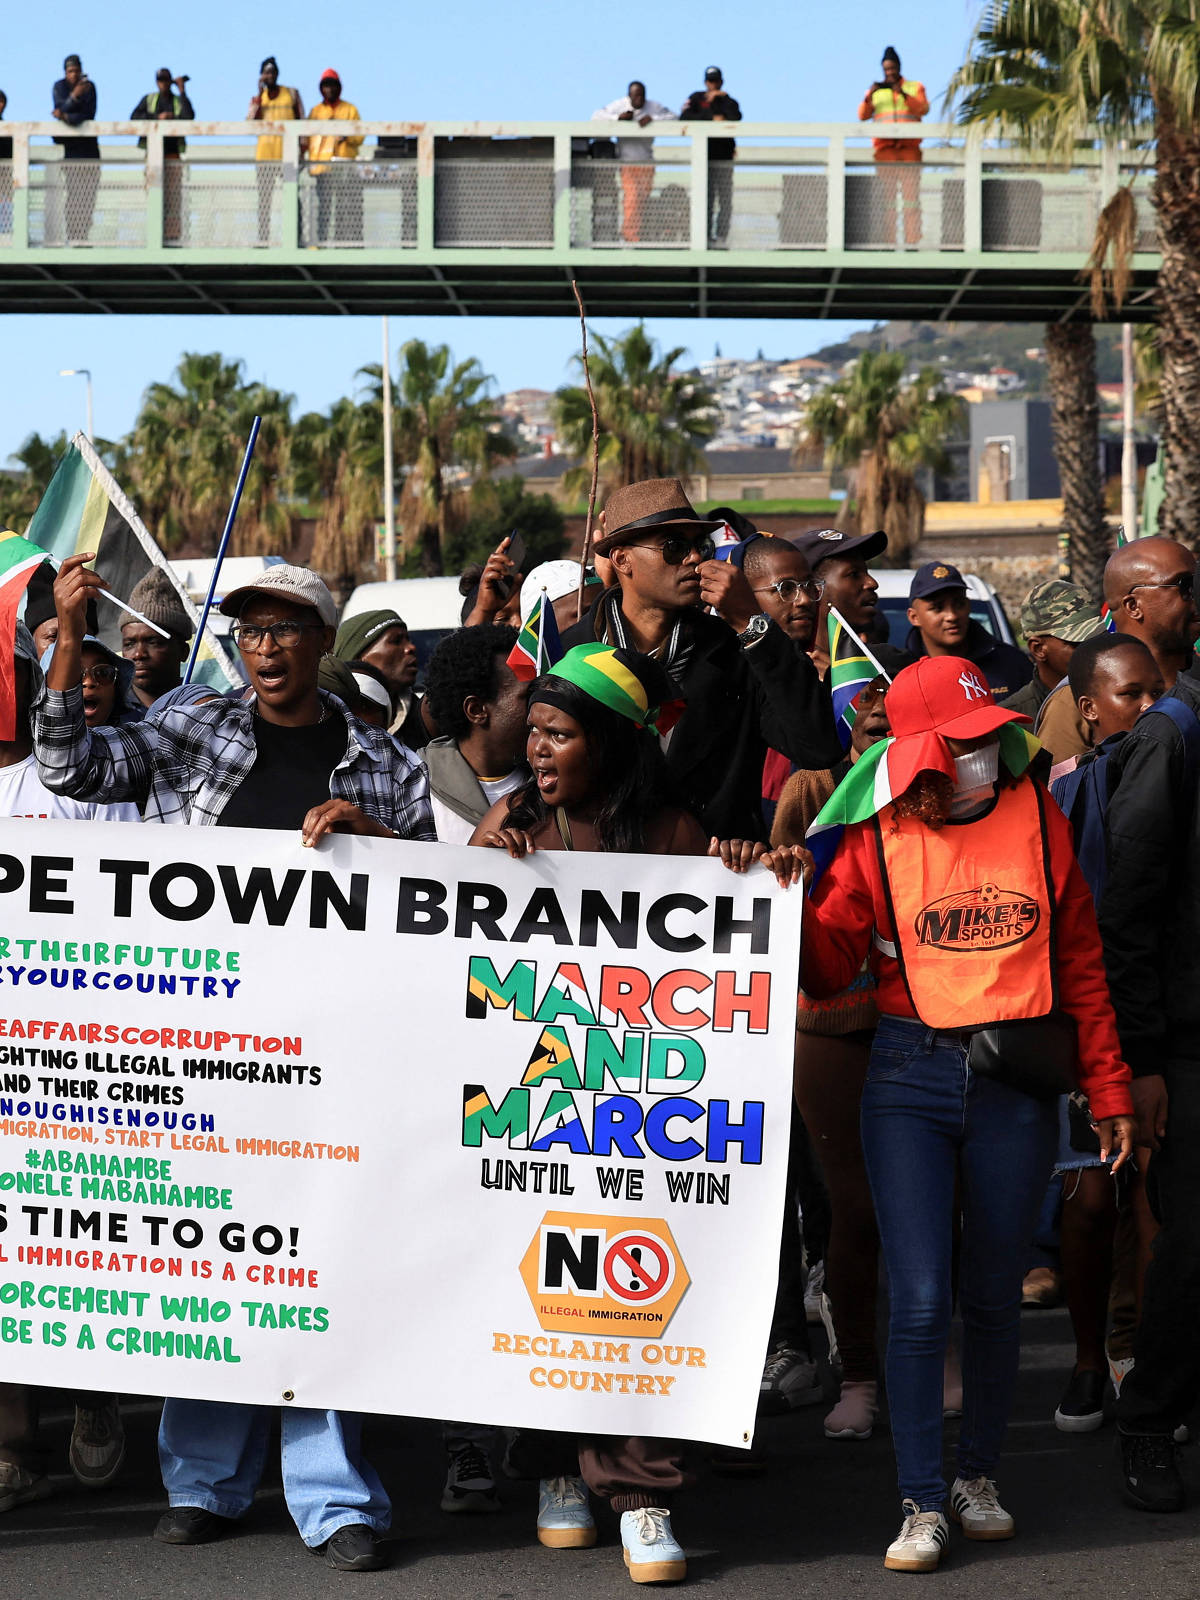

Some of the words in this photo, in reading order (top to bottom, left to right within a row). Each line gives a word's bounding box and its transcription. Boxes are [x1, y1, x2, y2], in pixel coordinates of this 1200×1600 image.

[958, 671, 987, 700] NY
[99, 858, 370, 932] TOWN
[395, 876, 772, 955] BRANCH
[918, 901, 1037, 944] MIKE'S
[961, 923, 1024, 941] SPORTS
[465, 956, 771, 1034] MARCH
[85, 1051, 176, 1077] ILLEGAL
[182, 1058, 322, 1086] IMMIGRANTS
[520, 1025, 707, 1094] AND
[37, 1076, 100, 1101] THEIR
[106, 1081, 184, 1106] CRIMES
[462, 1084, 764, 1165] MARCH
[104, 1128, 165, 1149] START
[170, 1133, 231, 1154] LEGAL
[235, 1137, 360, 1163] IMMIGRATION
[25, 1148, 172, 1182] #ABAHAMBE
[480, 1158, 575, 1196] UNTIL
[595, 1166, 645, 1201] WE
[664, 1170, 731, 1206] WIN
[80, 1177, 233, 1210] MABAHAMBE
[21, 1205, 128, 1244] TIME
[142, 1215, 204, 1249] TO
[218, 1222, 300, 1258] GO!
[18, 1245, 182, 1277] IMMIGRATION
[191, 1260, 213, 1279] IS
[222, 1261, 236, 1281] A
[246, 1264, 319, 1288] CRIME
[160, 1295, 232, 1323] WHO
[240, 1301, 329, 1333] TAKES
[540, 1305, 585, 1318] ILLEGAL
[588, 1309, 663, 1322] IMMIGRATION
[42, 1321, 67, 1347] IS
[76, 1323, 96, 1350] A
[106, 1327, 241, 1363] CRIMINAL
[492, 1332, 631, 1364] RECLAIM
[641, 1343, 707, 1369] OUR
[529, 1366, 676, 1396] COUNTRY
